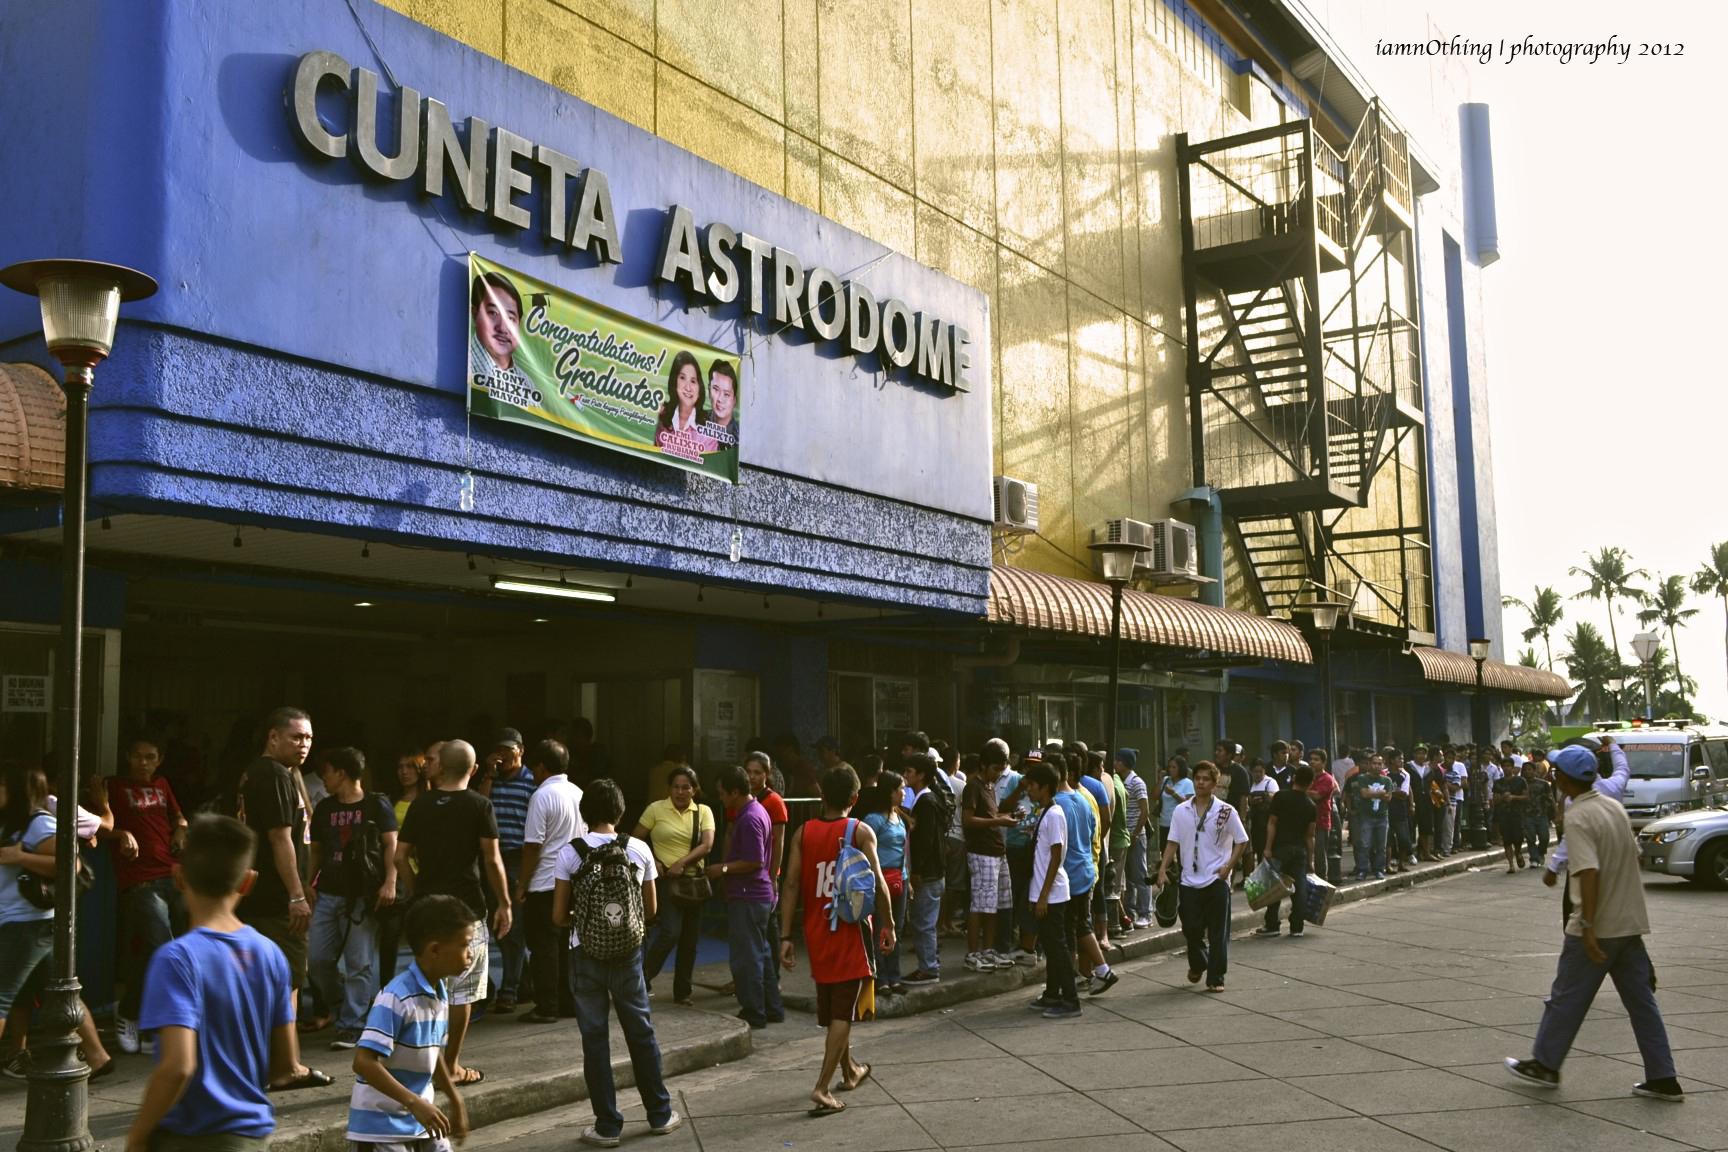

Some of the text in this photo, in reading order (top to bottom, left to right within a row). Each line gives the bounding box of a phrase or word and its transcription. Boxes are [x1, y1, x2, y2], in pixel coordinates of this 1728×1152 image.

[288, 50, 972, 394] CUNETA ASTRODOME
[526, 305, 667, 375] Congratulations!
[473, 373, 542, 402] CALIXTO
[495, 369, 526, 386] TONY
[555, 347, 664, 411] Graduates
[490, 389, 528, 408] MAYOR
[661, 433, 704, 452] CALIXTO
[697, 426, 735, 444] CALIXTO
